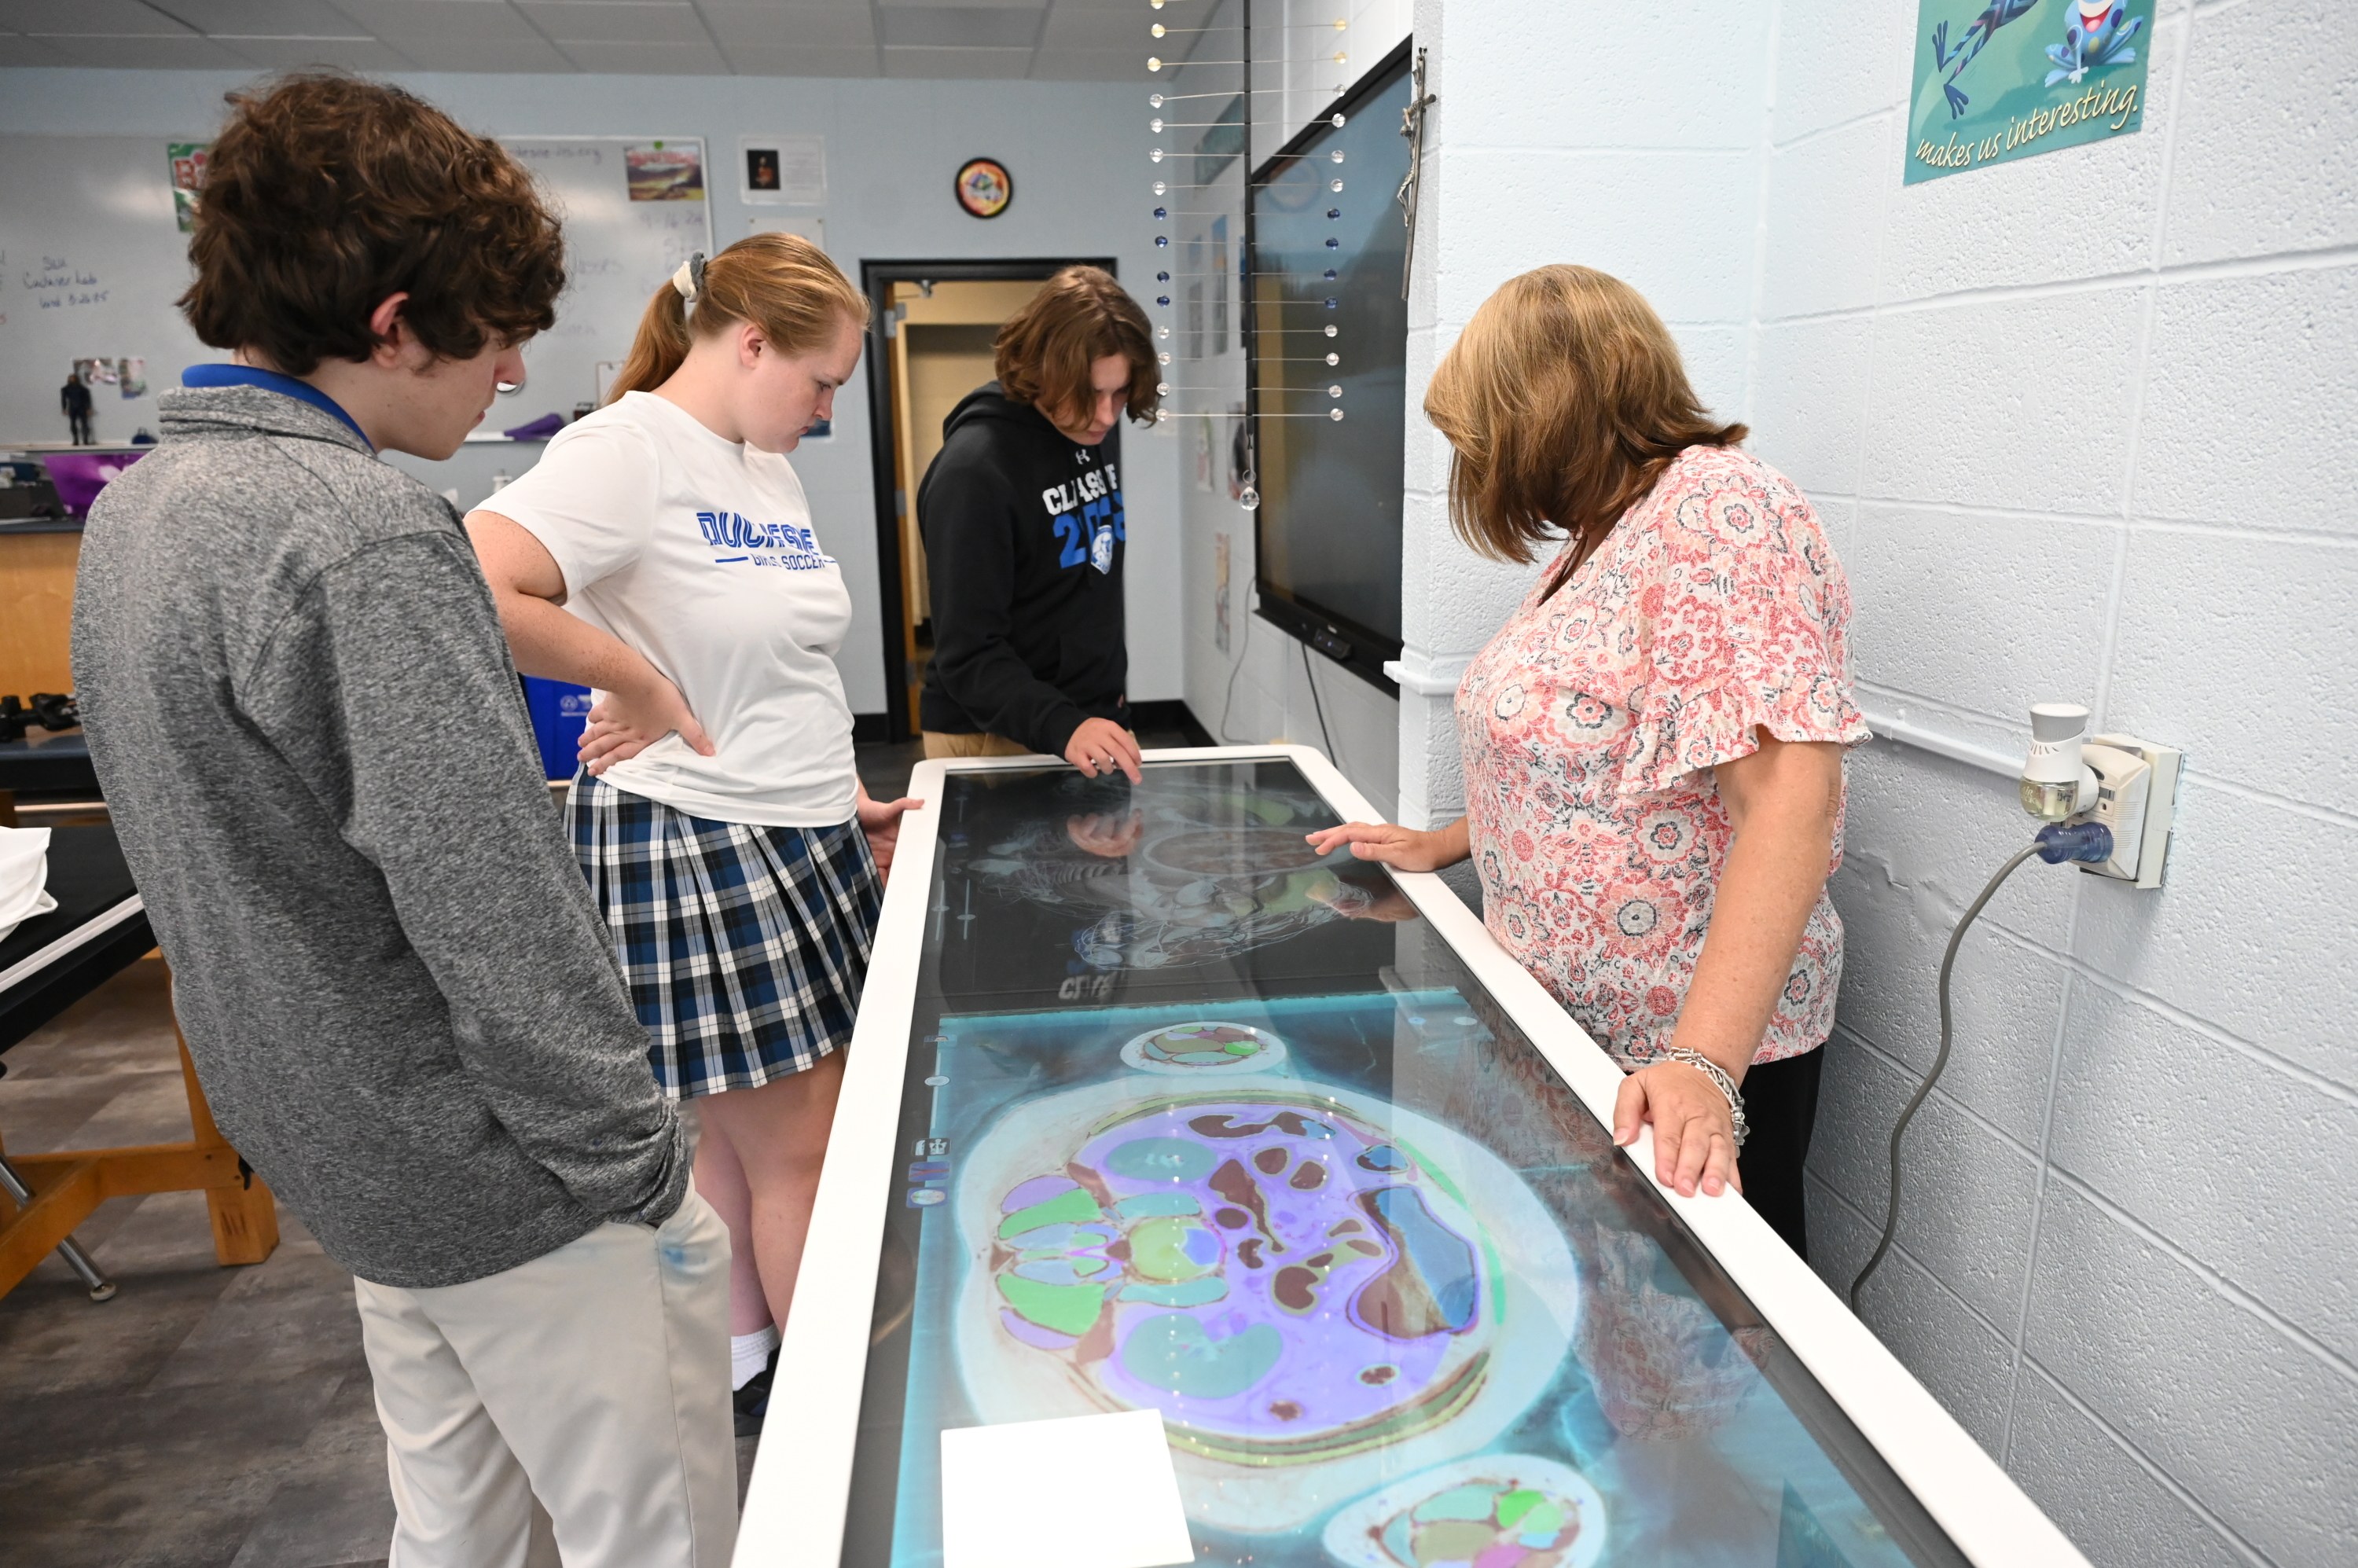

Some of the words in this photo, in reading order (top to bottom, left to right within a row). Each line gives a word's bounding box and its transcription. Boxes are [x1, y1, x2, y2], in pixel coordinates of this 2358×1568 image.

[1915, 131, 1974, 168] makes
[1978, 132, 2002, 162] us
[2006, 79, 2139, 151] interesting.
